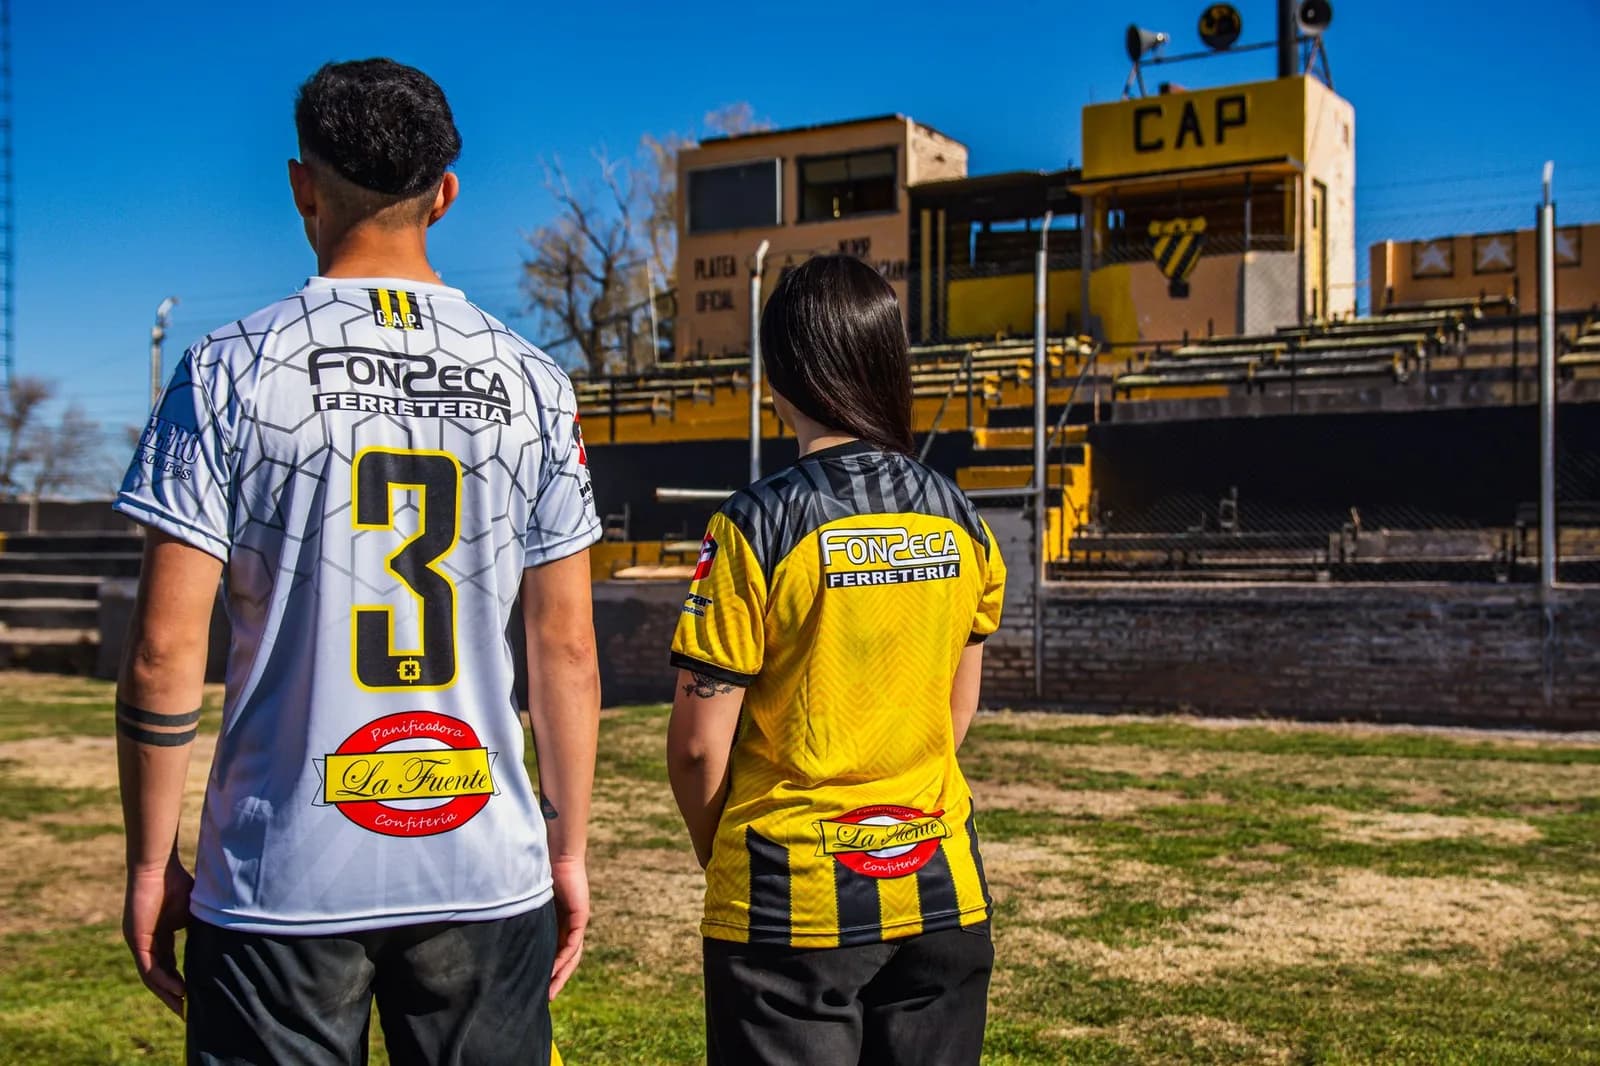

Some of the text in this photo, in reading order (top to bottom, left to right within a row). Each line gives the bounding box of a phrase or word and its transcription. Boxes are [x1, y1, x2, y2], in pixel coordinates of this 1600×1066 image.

[1133, 94, 1247, 153] CAP
[376, 309, 421, 328] C.A.P.
[308, 346, 511, 407] FONSECA
[819, 527, 960, 567] FONSECA
[351, 445, 462, 692] 3
[371, 720, 465, 742] Panificadora
[335, 757, 488, 797] La Fuente
[832, 825, 877, 848] La
